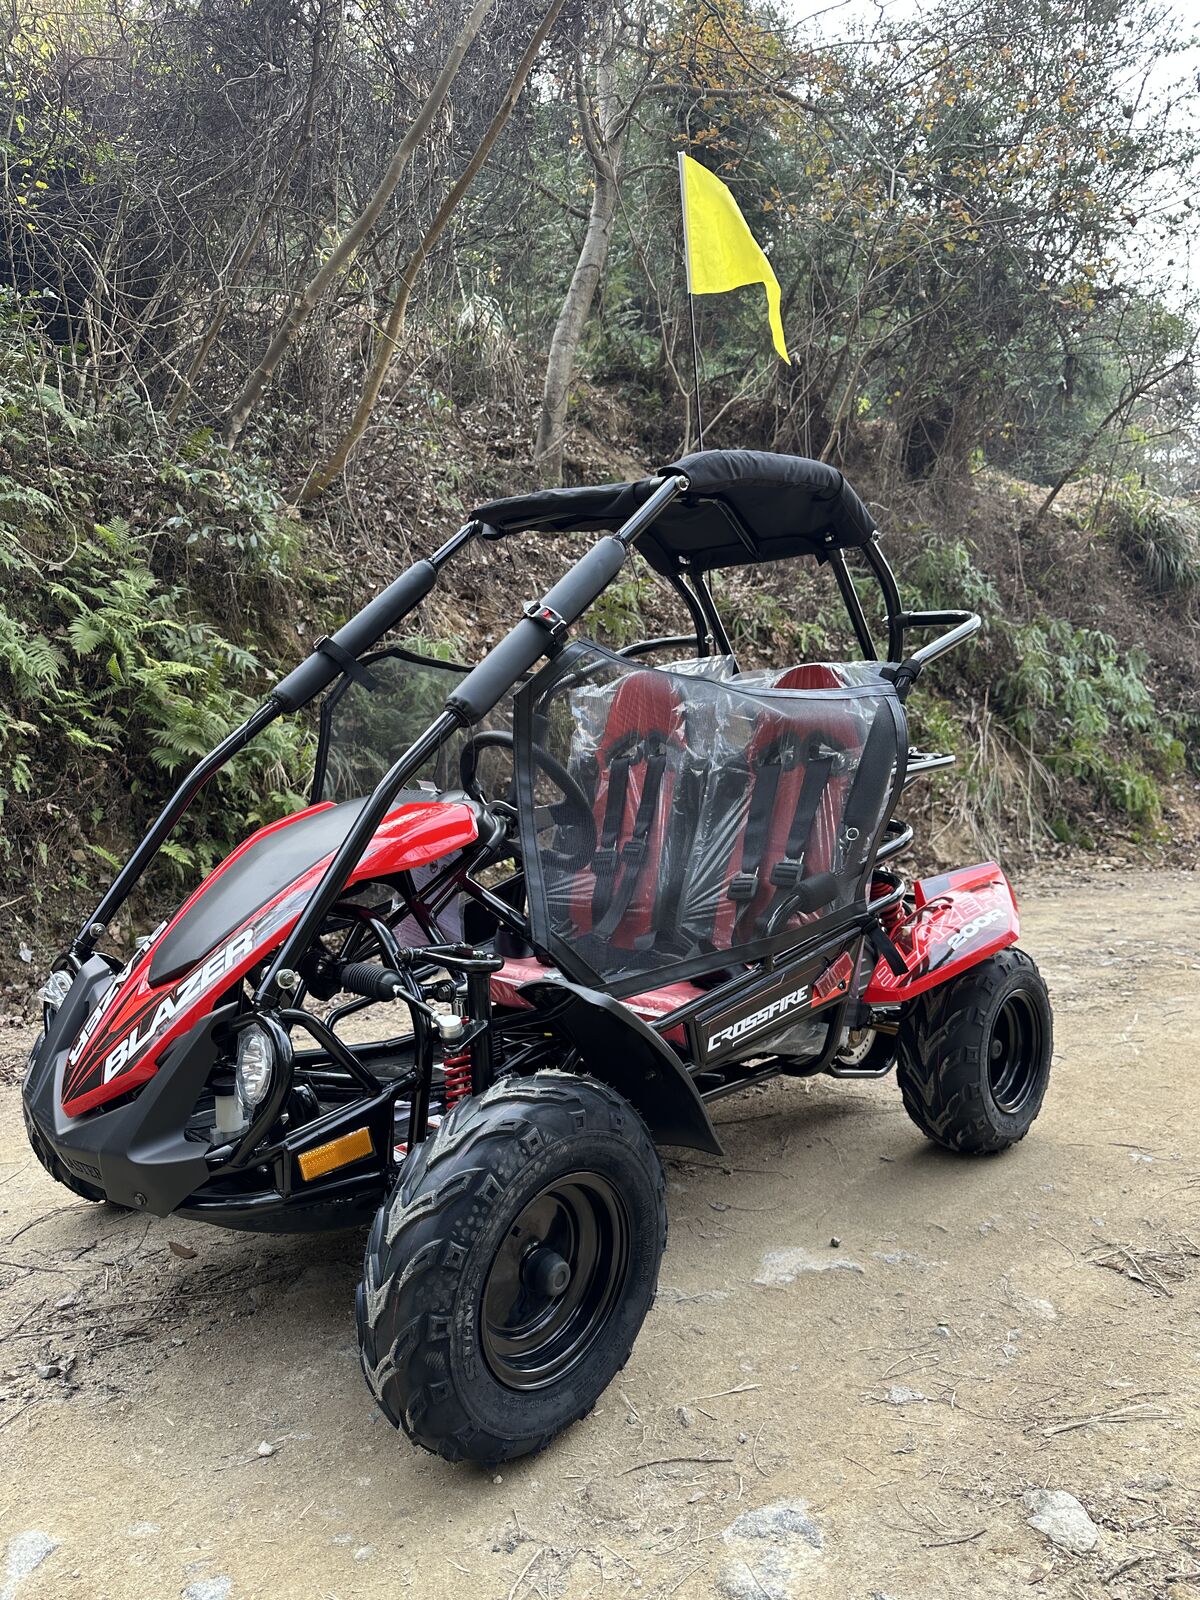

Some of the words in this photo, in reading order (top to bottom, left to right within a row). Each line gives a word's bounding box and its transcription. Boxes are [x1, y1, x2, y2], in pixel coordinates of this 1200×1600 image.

[946, 907, 1007, 950] 200R
[102, 928, 257, 1085] BLAZER
[707, 984, 809, 1053] CROSSFIRE
